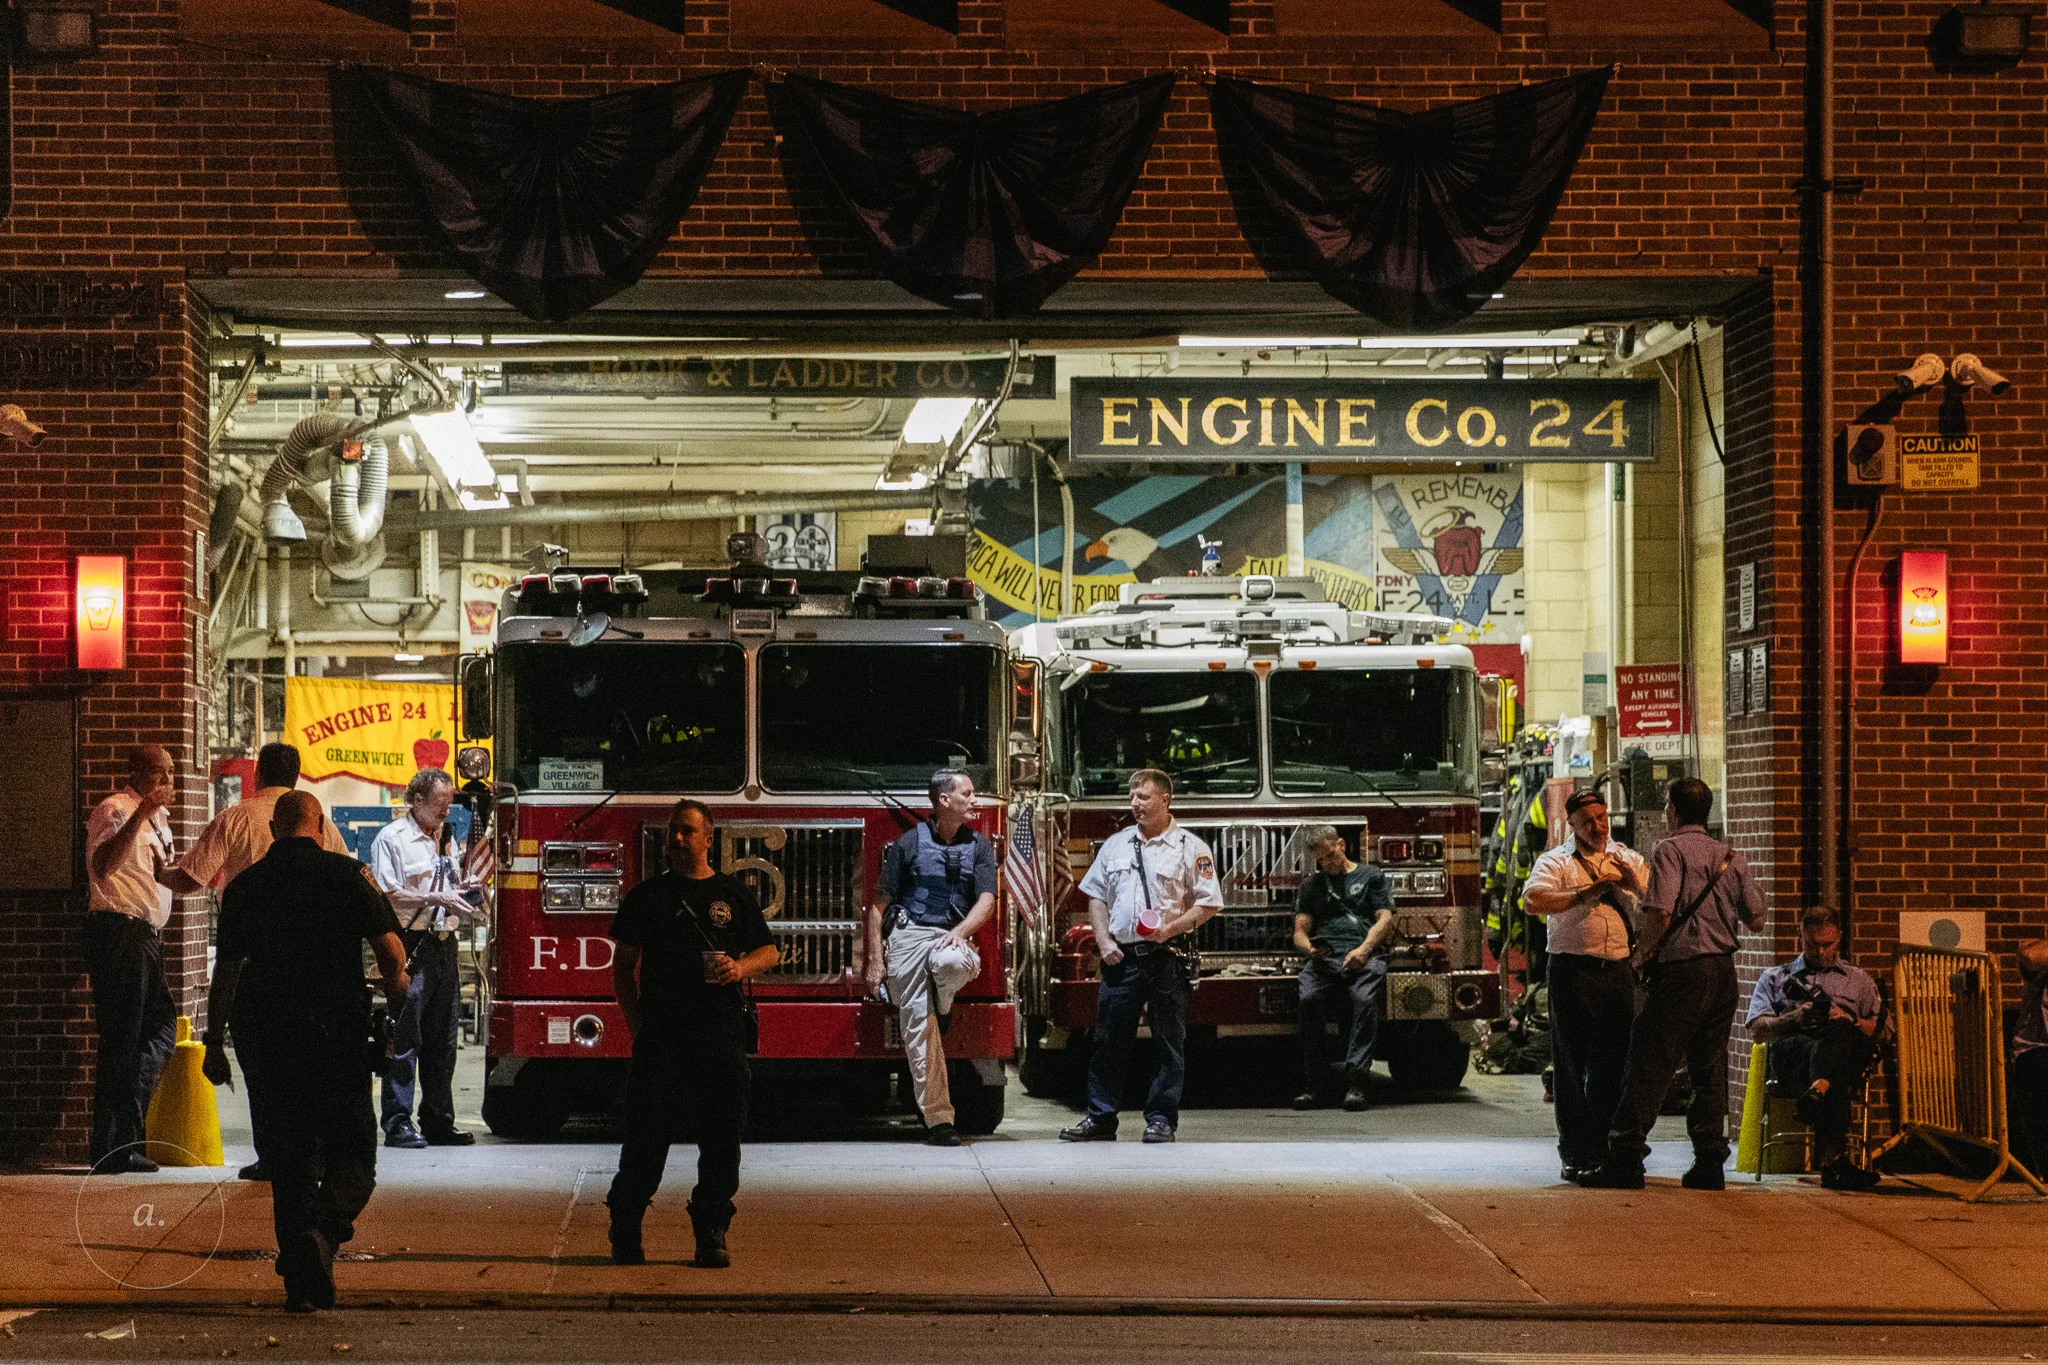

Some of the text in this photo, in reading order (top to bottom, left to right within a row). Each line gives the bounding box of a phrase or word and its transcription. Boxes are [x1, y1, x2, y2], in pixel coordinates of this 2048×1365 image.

[706, 360, 732, 387] &
[747, 359, 898, 388] LADDER
[916, 361, 976, 389] CO.
[1100, 397, 1631, 448] ENGINE Co. 24
[1904, 437, 1976, 453] CAUTION
[1911, 479, 1921, 487] DO
[1922, 479, 1936, 487] NOT
[993, 556, 1033, 601] WILL
[1376, 575, 1413, 587] FDNY
[1620, 673, 1634, 685] NO
[1631, 688, 1675, 701] ANY TIME
[1641, 710, 1668, 718] VEHICLES
[302, 702, 392, 746] ENGINE
[402, 702, 427, 720] 24
[326, 748, 405, 767] GREENWICH
[543, 771, 600, 781] GREENWICH
[552, 781, 592, 790] VILLAGE
[721, 826, 788, 922] 5
